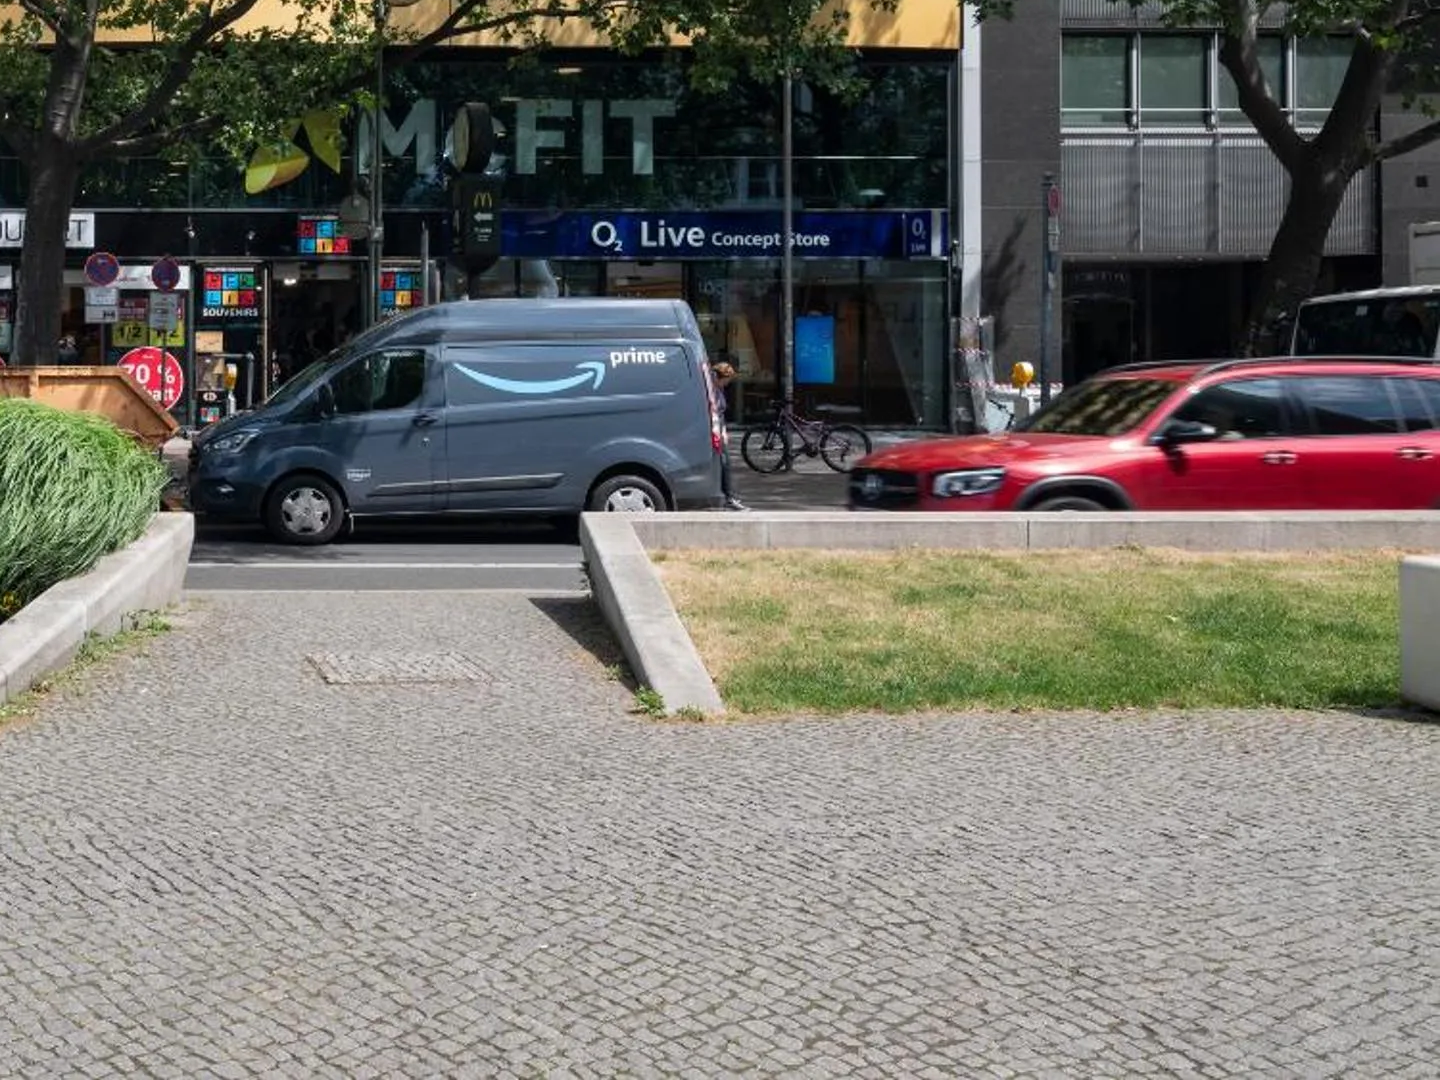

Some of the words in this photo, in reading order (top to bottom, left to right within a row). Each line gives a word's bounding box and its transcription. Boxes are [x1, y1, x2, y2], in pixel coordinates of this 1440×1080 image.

[640, 220, 705, 248] Live
[711, 231, 782, 248] Concept
[787, 231, 831, 247] Store
[202, 307, 259, 318] SOUVENIRS
[118, 325, 143, 340] 1/2
[609, 346, 667, 369] prime
